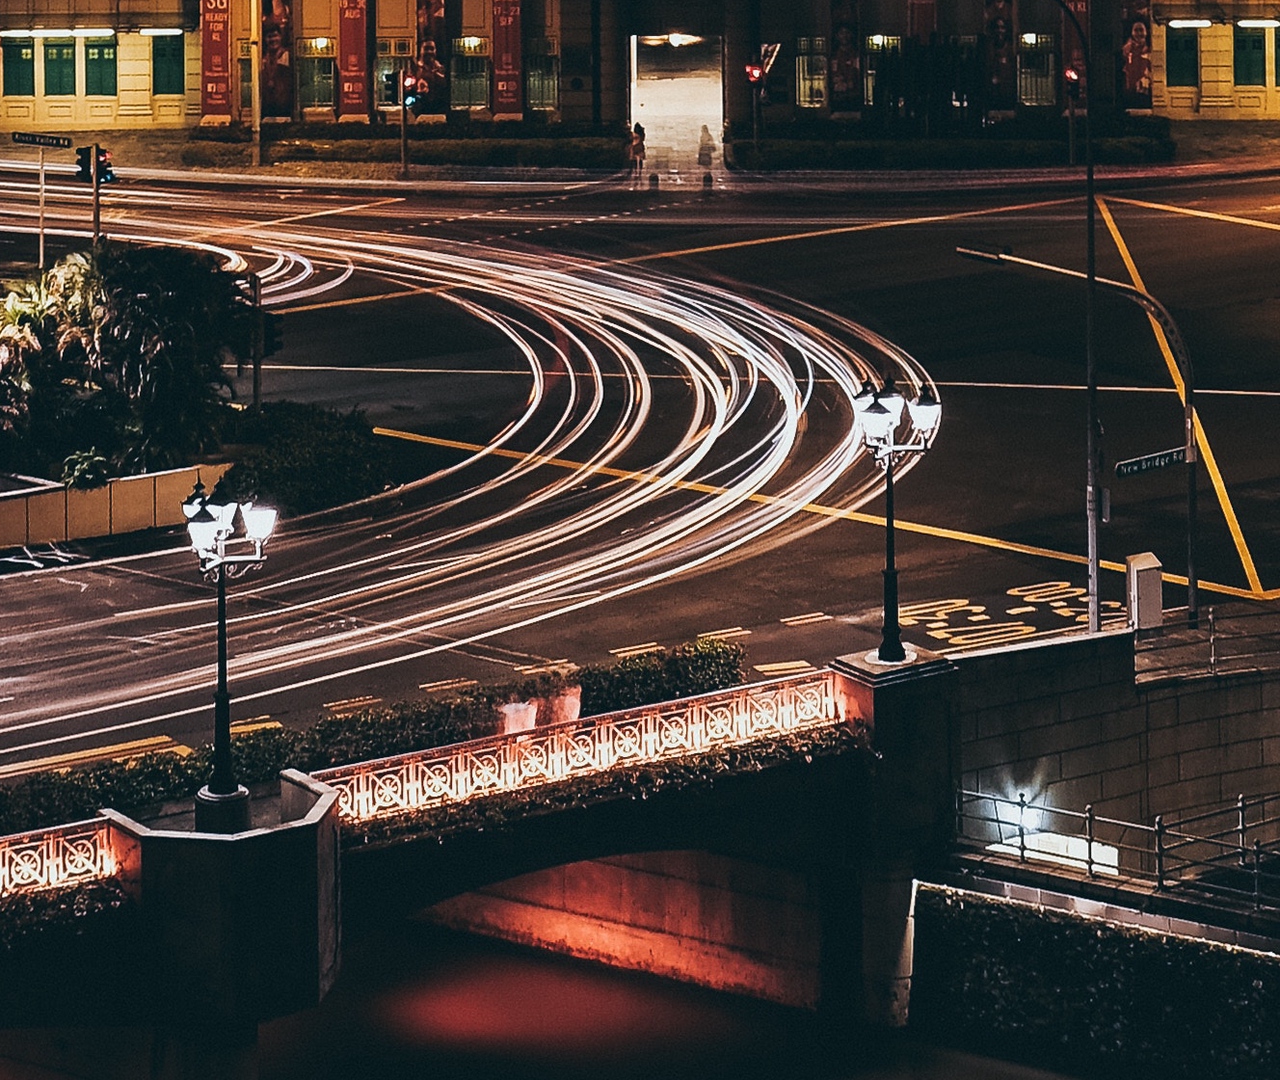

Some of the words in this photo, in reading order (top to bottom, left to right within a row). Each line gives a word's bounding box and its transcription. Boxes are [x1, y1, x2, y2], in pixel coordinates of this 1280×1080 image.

[205, 13, 229, 21] READY
[344, 9, 360, 19] AUG
[209, 23, 224, 31] FOR
[1121, 465, 1138, 474] New
[1141, 456, 1170, 470] Bridge
[1173, 451, 1184, 461] Rd
